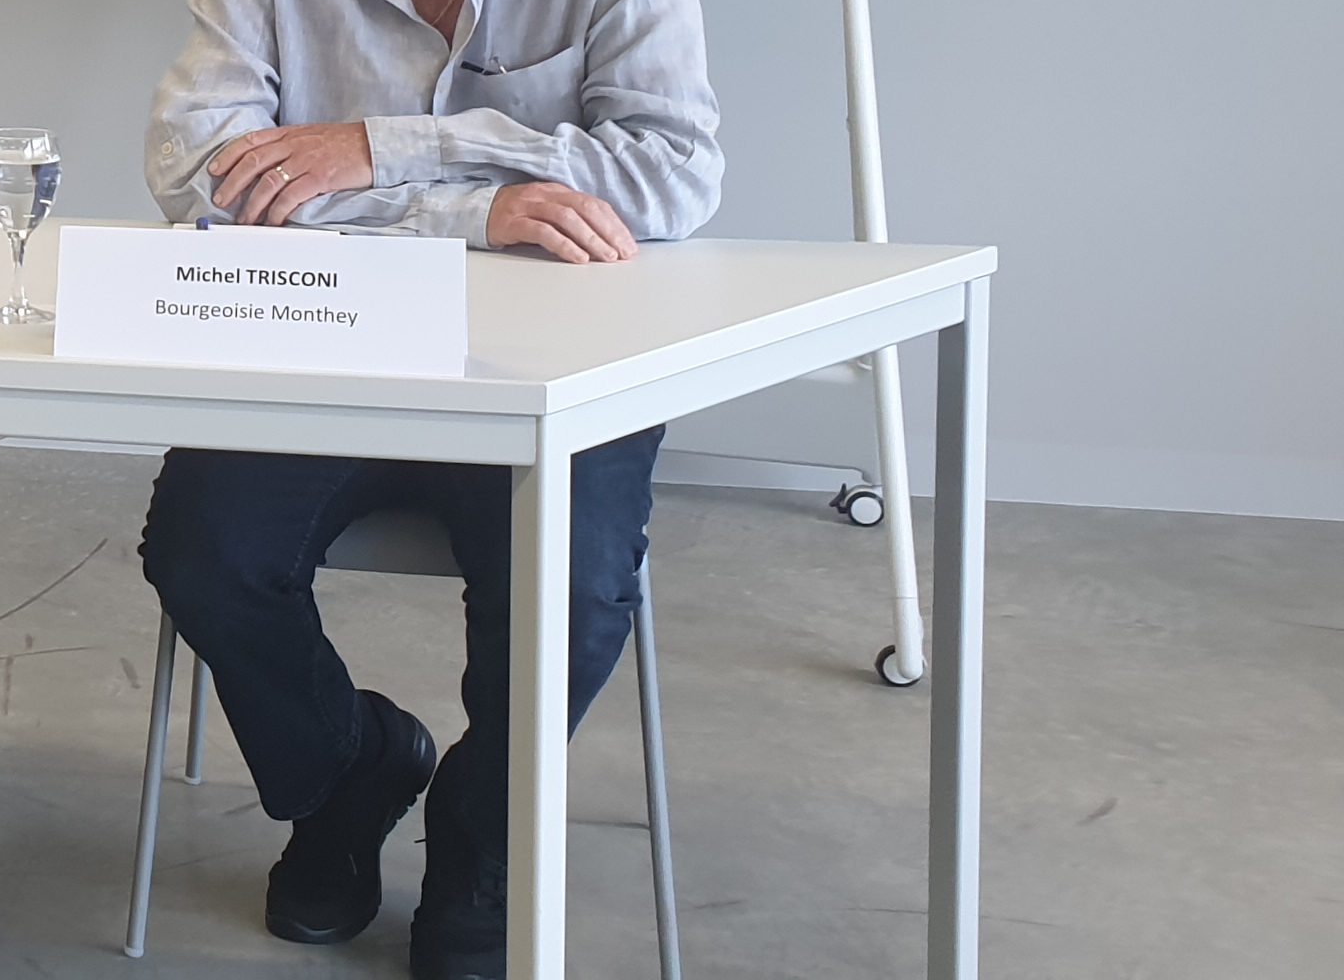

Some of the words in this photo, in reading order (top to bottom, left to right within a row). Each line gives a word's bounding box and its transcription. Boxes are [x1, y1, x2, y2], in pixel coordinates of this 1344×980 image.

[176, 266, 240, 284] Michel
[246, 269, 338, 288] TRISCONI
[154, 299, 265, 321] Bourgeoisie
[271, 304, 358, 327] Monthey
